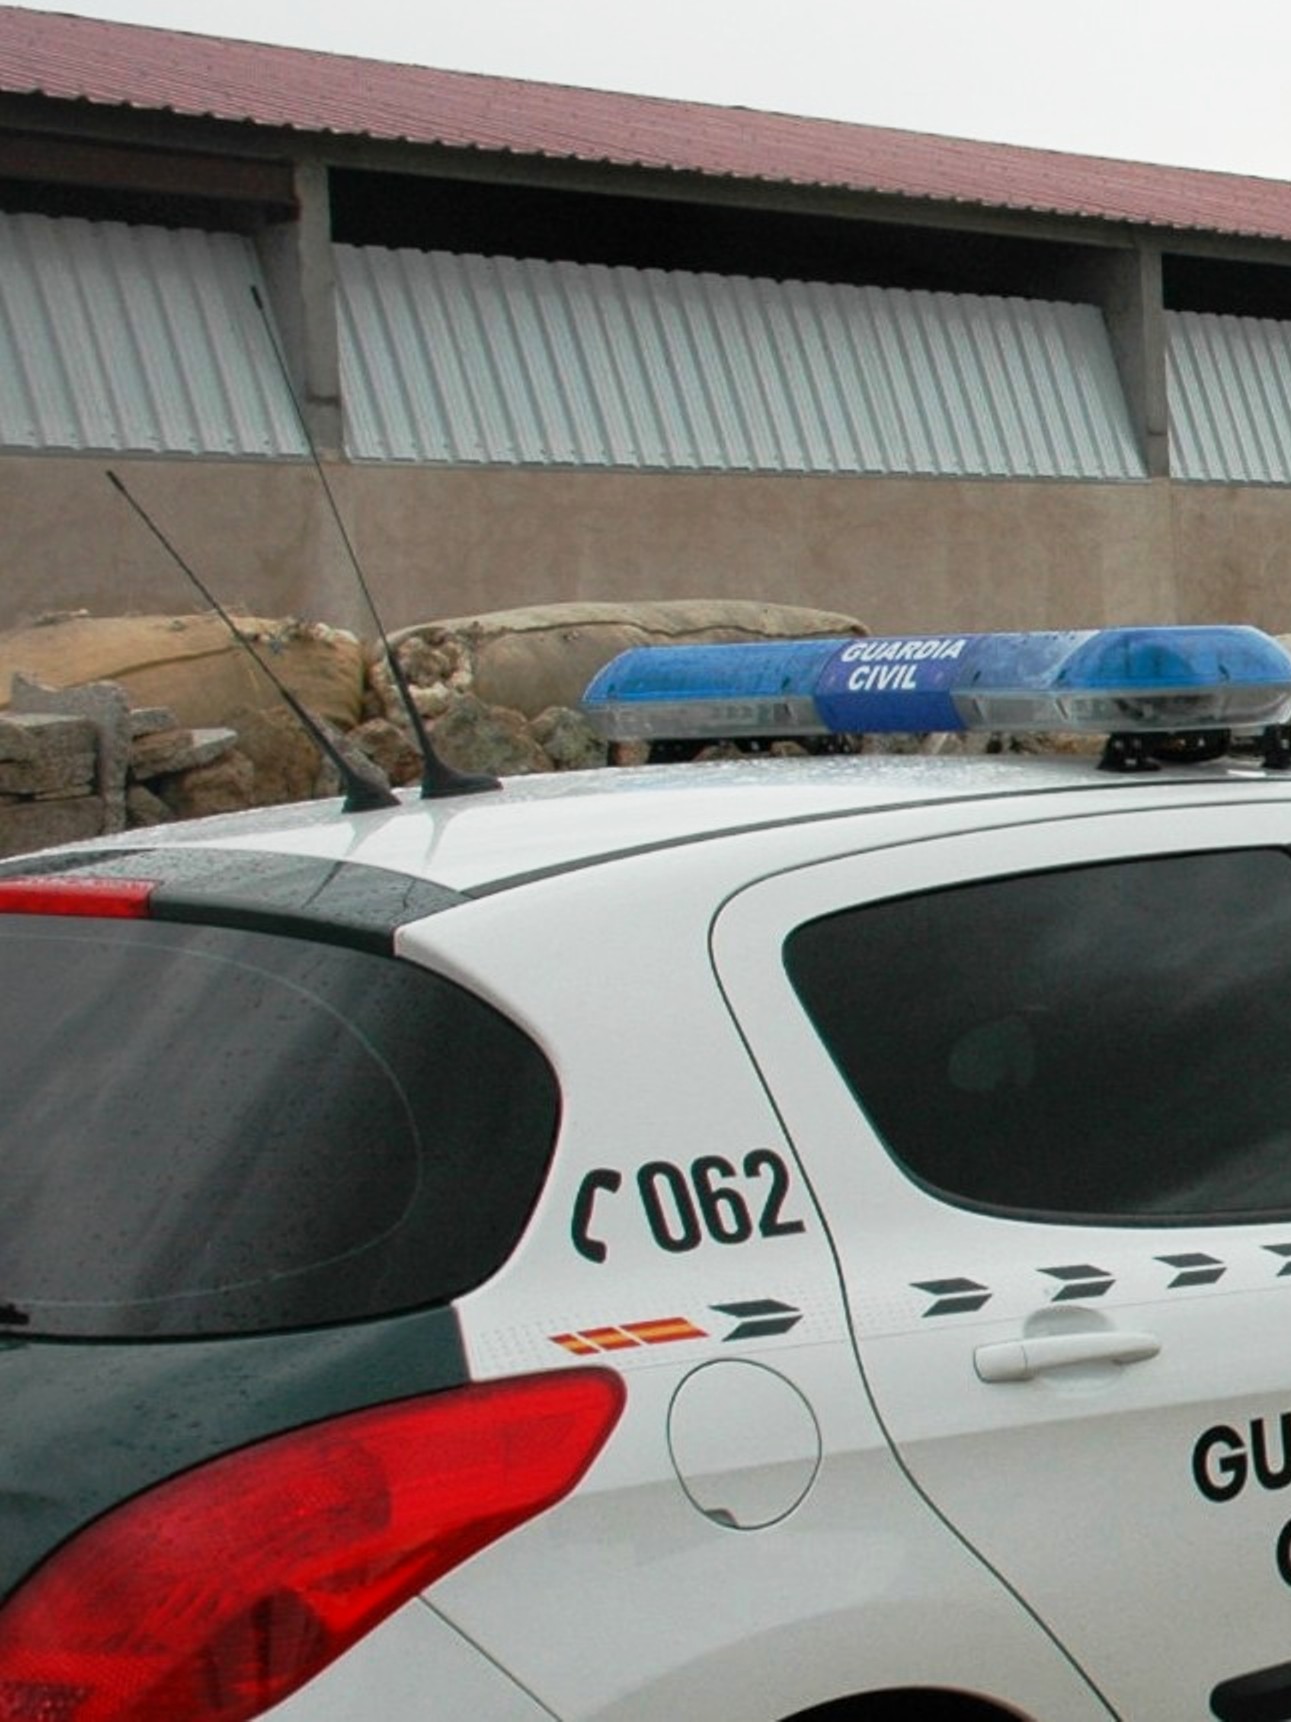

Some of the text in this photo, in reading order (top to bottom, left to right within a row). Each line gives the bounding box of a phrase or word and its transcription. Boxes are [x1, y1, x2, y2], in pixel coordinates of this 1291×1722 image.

[841, 639, 968, 662] GUARDIA
[848, 664, 917, 691] CIVIL
[636, 1148, 806, 1253] 062
